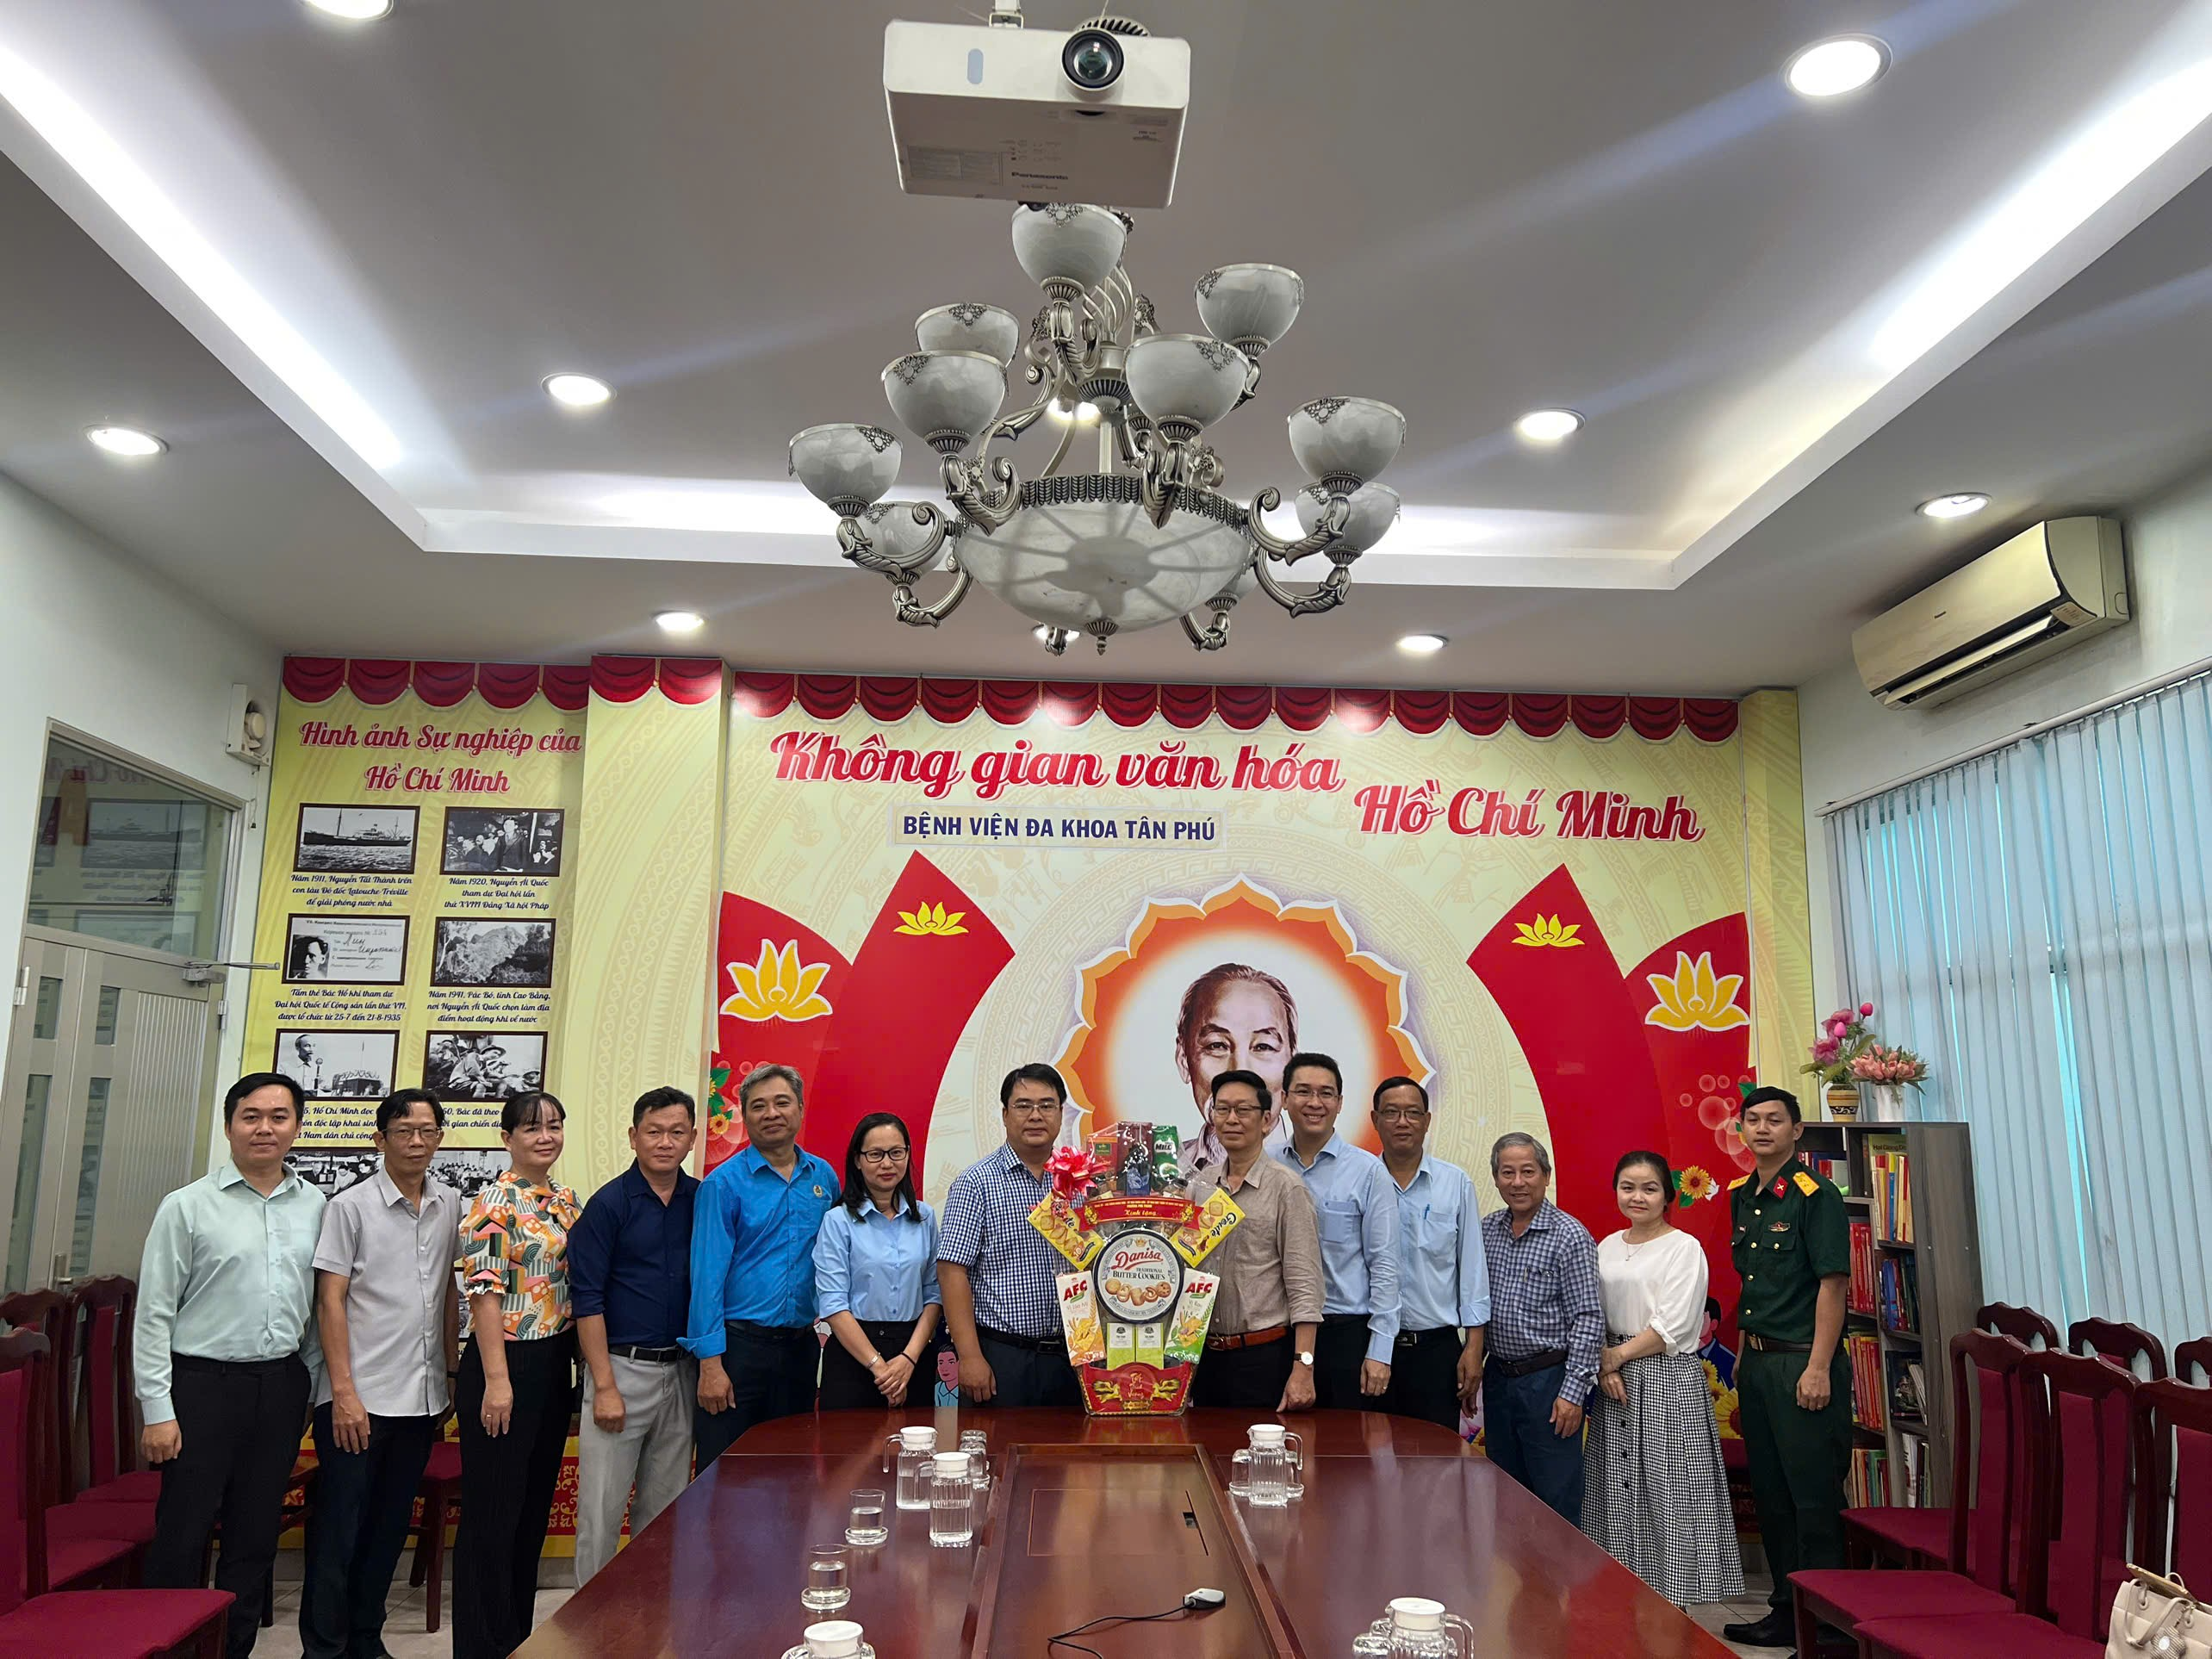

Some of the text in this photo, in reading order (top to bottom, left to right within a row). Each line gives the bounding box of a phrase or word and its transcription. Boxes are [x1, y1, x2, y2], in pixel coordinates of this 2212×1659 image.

[299, 721, 582, 758] Hình ảnh Sự nghiệp của
[769, 730, 1346, 801] Không gian văn hóa
[364, 762, 510, 793] Hồ Chí Minh
[1353, 779, 1706, 842] Hồ Chí Minh
[904, 811, 1215, 841] BỆNH VIỆN ĐA KHOA TÂN PHÚ
[329, 875, 357, 885] Nguyễn
[490, 877, 518, 887] Nguyễn
[529, 991, 550, 1000] Bằng,
[331, 1002, 348, 1010] Cộng
[441, 1003, 469, 1011] Nguyễn
[451, 1121, 469, 1129] gian
[1111, 1248, 1164, 1271] Danisa
[1138, 1271, 1165, 1280] COOKIES
[1064, 1280, 1088, 1302] AFC
[1185, 1283, 1213, 1293] AFC
